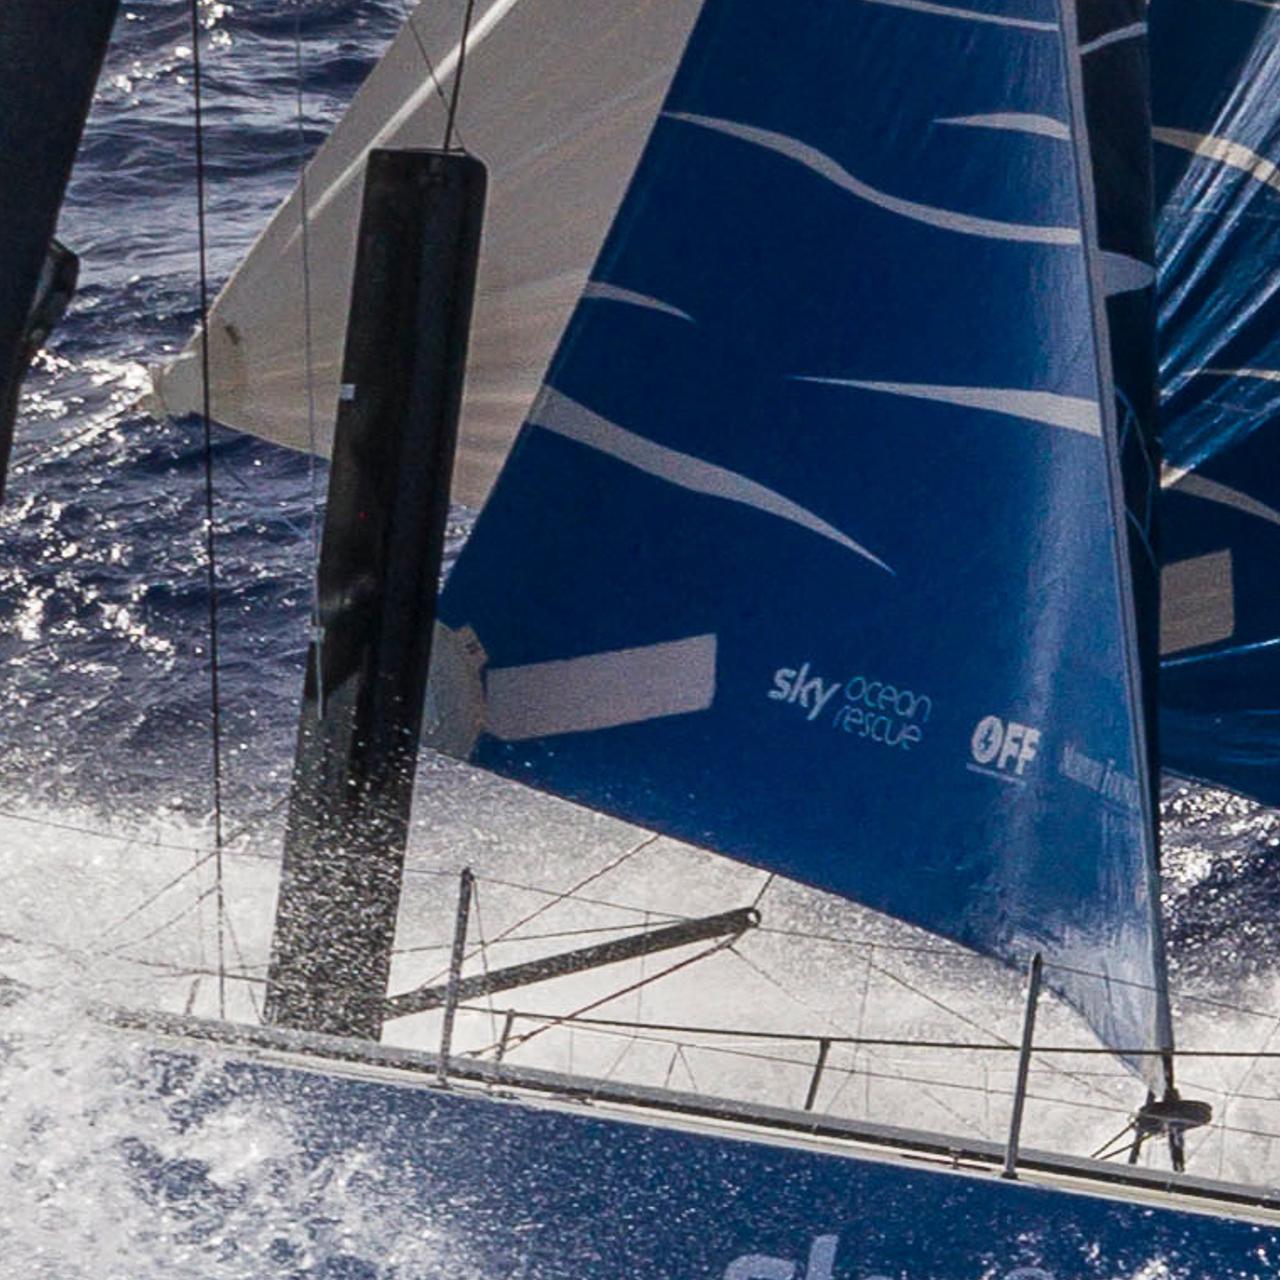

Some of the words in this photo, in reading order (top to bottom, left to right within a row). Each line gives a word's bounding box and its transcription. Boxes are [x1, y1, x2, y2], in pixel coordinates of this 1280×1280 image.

[767, 662, 843, 721] sky
[844, 676, 933, 723] ocean
[831, 703, 922, 751] rescue
[970, 715, 1042, 775] OFF
